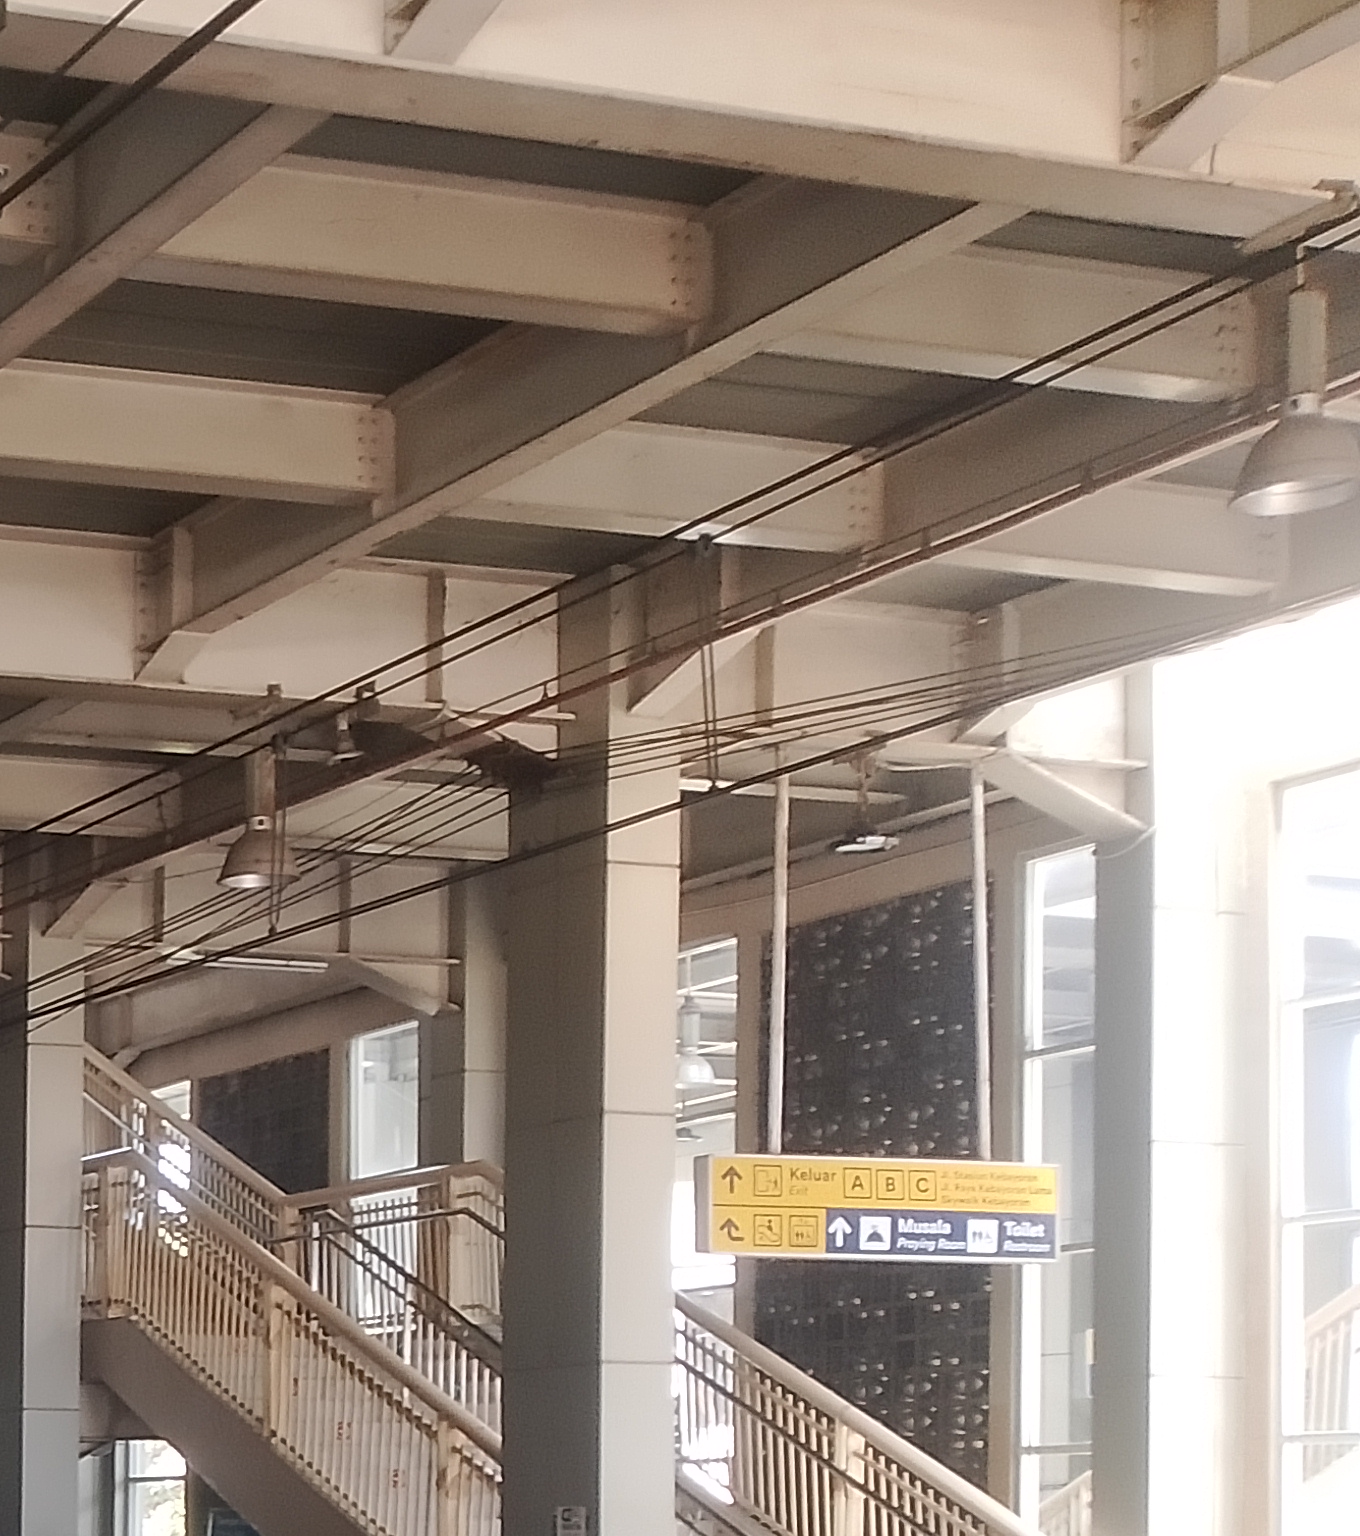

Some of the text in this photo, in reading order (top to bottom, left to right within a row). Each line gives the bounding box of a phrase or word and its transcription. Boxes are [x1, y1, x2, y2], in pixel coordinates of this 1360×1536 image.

[790, 1167, 837, 1182] Keluar
[851, 1175, 865, 1190] A
[885, 1177, 896, 1192] B
[916, 1177, 930, 1193] C
[898, 1217, 951, 1235] Musala
[1003, 1221, 1045, 1238] Toilet
